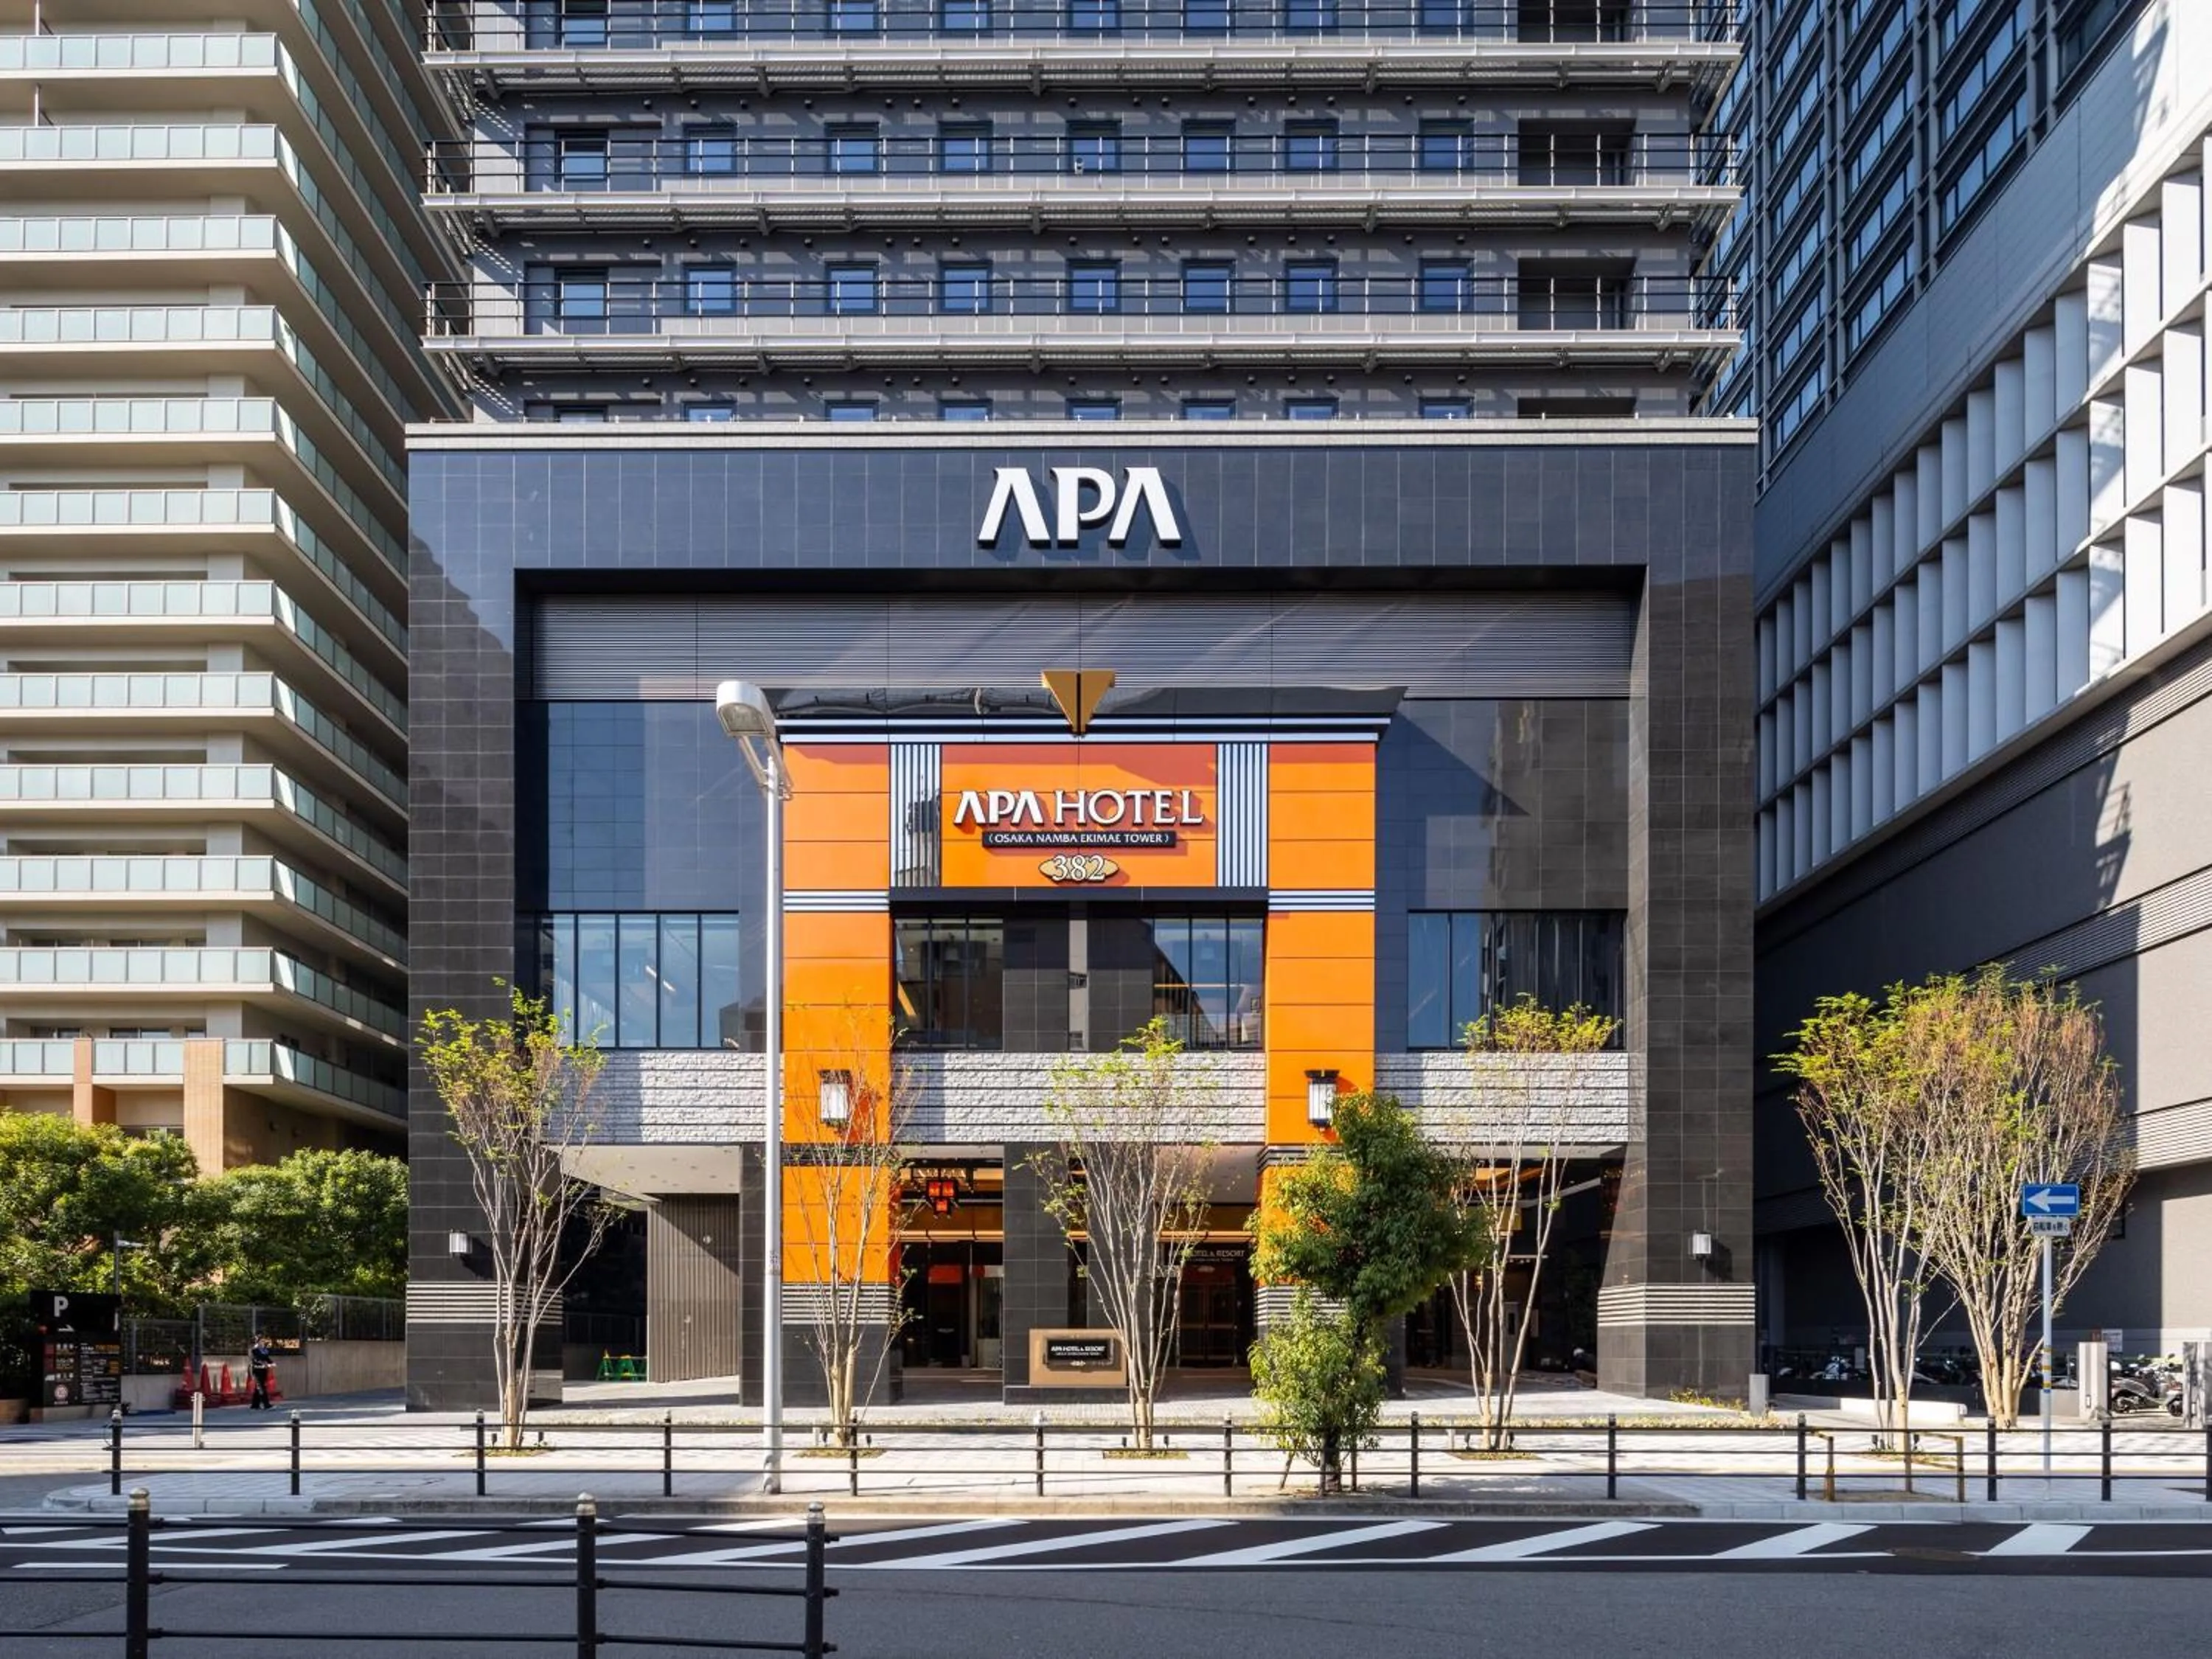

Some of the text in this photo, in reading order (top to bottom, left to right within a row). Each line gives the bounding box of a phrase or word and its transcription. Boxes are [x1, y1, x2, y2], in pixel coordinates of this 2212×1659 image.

[978, 467, 1182, 548] APA
[953, 790, 1205, 825] APA HOTEL
[1035, 833, 1078, 844] NAMBA
[1080, 833, 1122, 844] EKIMAE
[1051, 855, 1106, 881] 382
[54, 1295, 69, 1318] P
